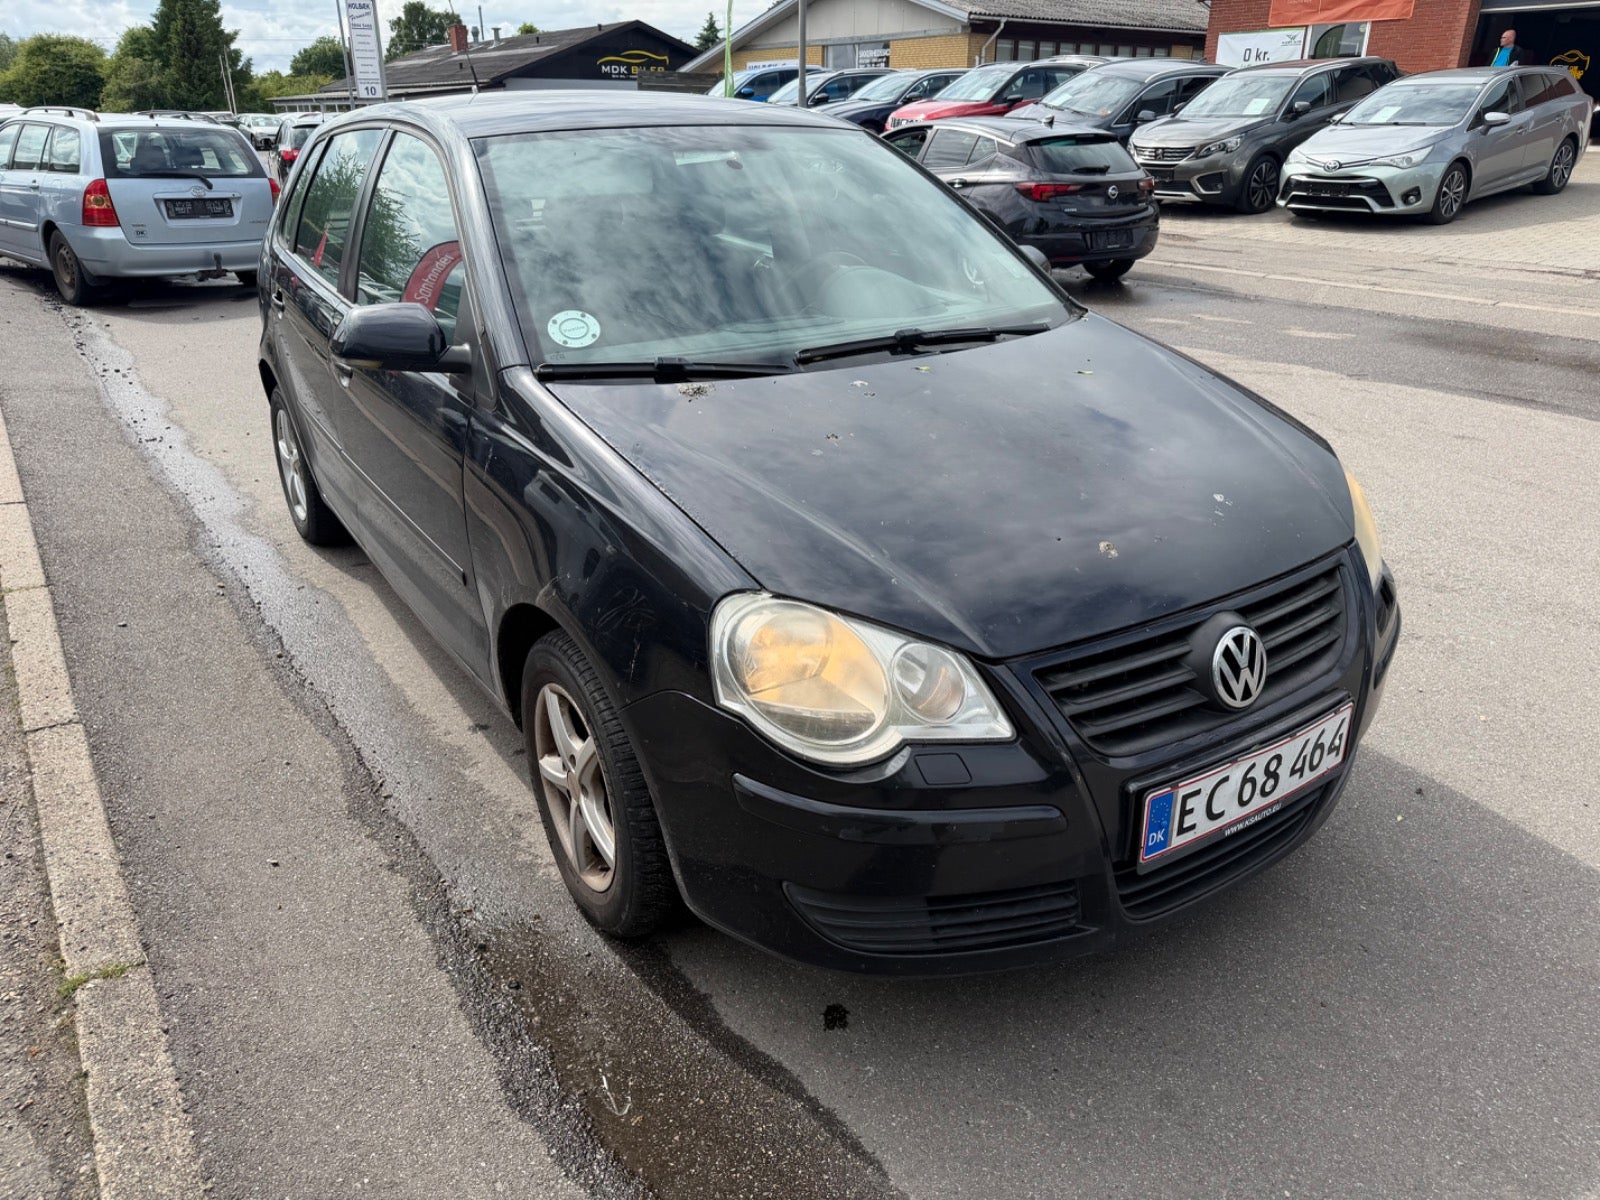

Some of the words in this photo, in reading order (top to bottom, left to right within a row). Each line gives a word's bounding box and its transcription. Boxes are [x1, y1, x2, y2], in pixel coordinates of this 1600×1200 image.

[1243, 47, 1252, 62] 0
[1255, 47, 1270, 62] kr.
[601, 65, 628, 74] MDK
[364, 86, 377, 96] 10
[414, 254, 455, 304] Santander
[1176, 775, 1230, 837] EC
[1237, 753, 1283, 807] 68
[1289, 717, 1346, 780] 464
[1147, 832, 1165, 847] DK
